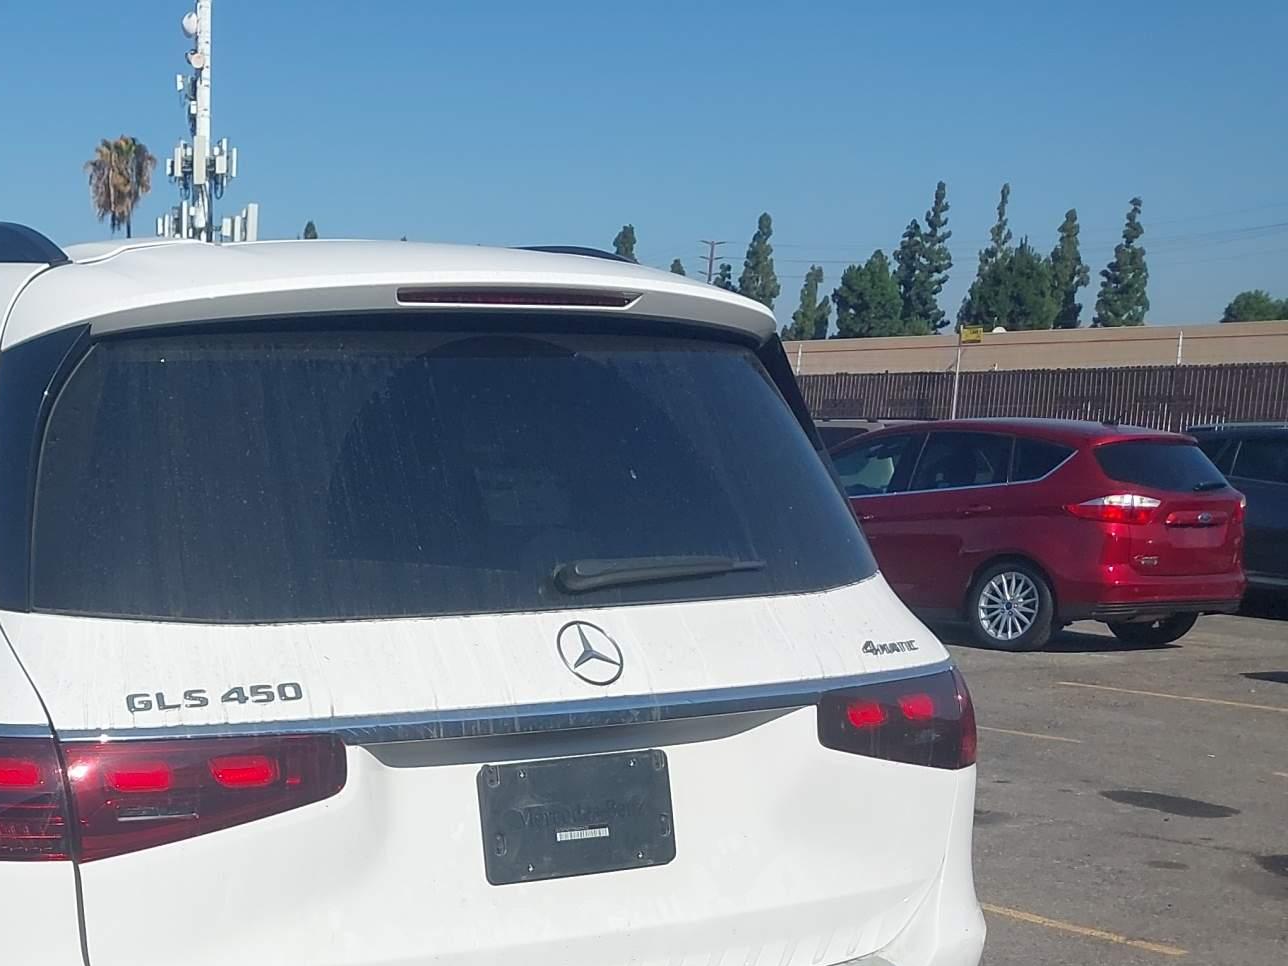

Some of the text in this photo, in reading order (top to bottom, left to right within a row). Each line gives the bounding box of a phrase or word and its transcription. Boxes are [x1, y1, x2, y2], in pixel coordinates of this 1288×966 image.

[862, 640, 919, 656] 4MATIC
[126, 682, 303, 713] GLS 450
